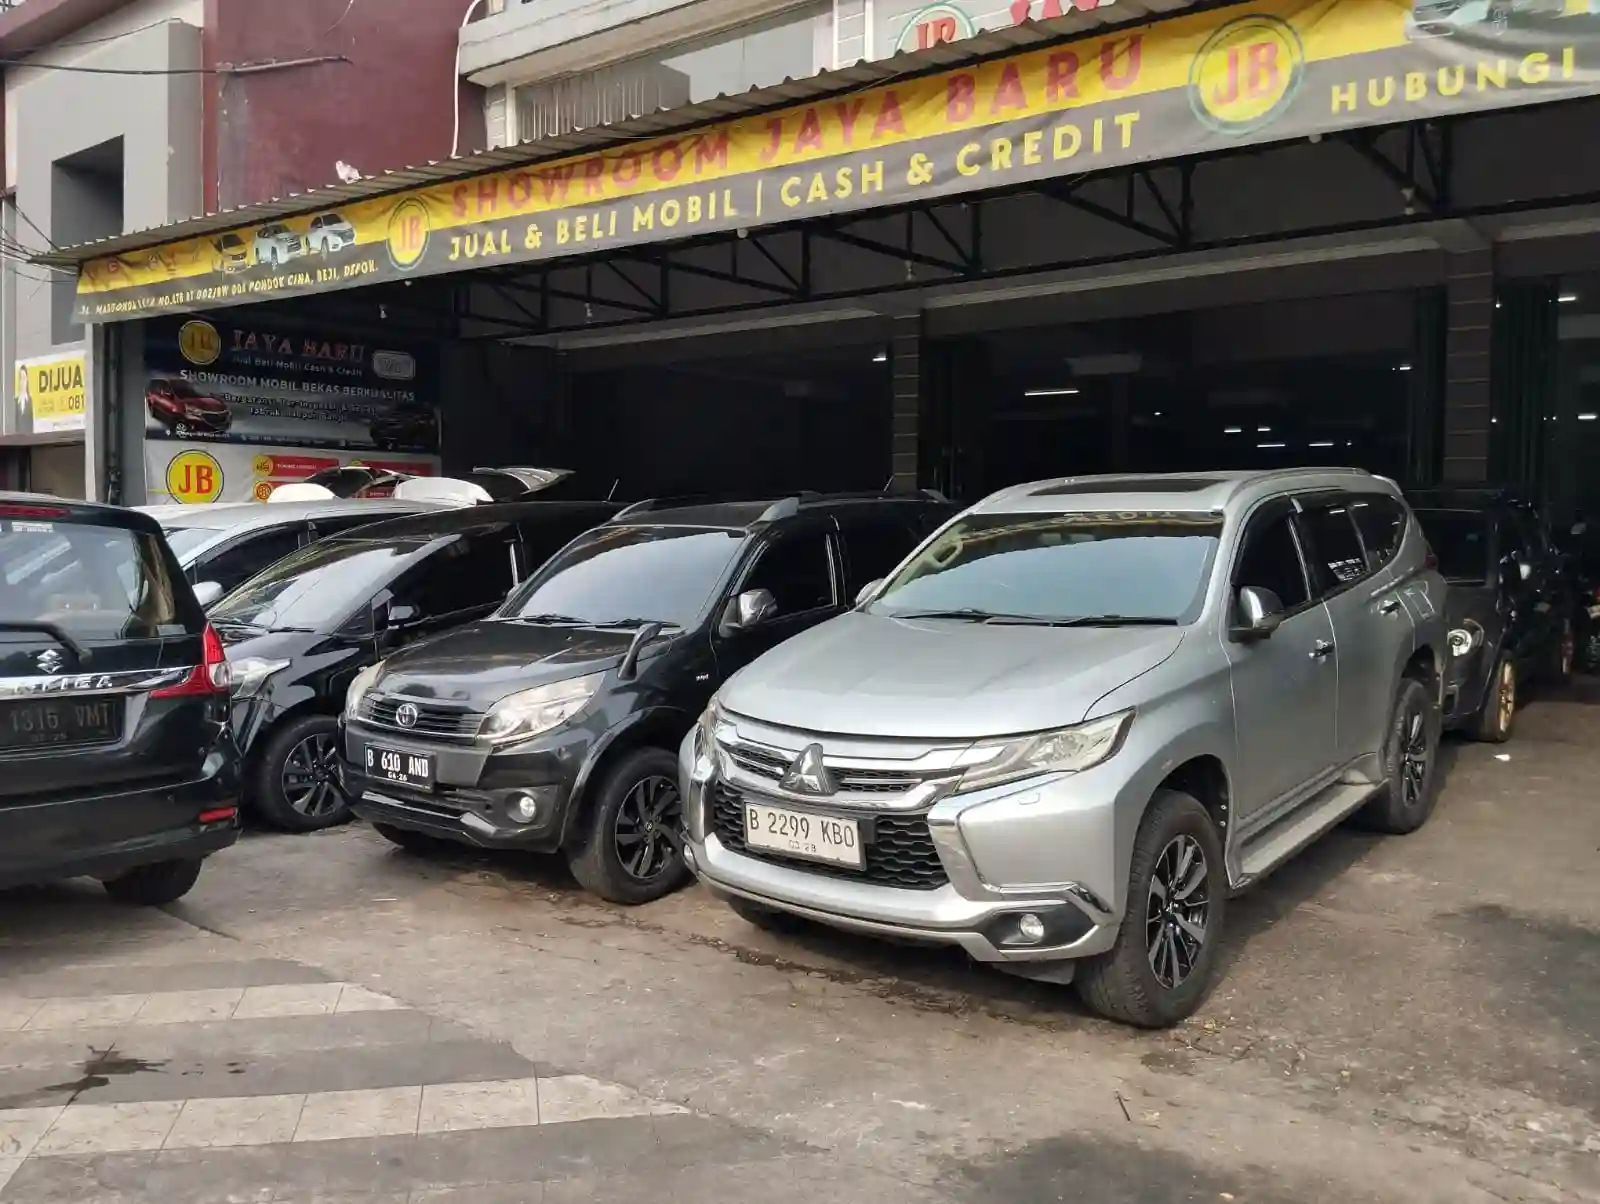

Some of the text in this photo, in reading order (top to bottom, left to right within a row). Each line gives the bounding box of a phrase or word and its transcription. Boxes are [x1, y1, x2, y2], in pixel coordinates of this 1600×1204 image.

[1212, 41, 1279, 107] JB
[1331, 47, 1575, 115] HUBUNGI
[451, 33, 1144, 219] SHOWROOM JAYA BARU
[449, 230, 511, 261] JUAL
[524, 224, 543, 249] &
[556, 210, 617, 244] BELI
[633, 189, 738, 232] MOBIL
[780, 160, 884, 207] CASH
[906, 153, 935, 185] &
[956, 110, 1140, 177] CREDIT
[180, 370, 416, 402] SHOWROOM MOBIL BEKAS BERKUALITAS
[178, 467, 213, 495] JB
[367, 749, 429, 778] B 610 AND
[749, 808, 760, 830] B
[768, 812, 810, 840] 2299
